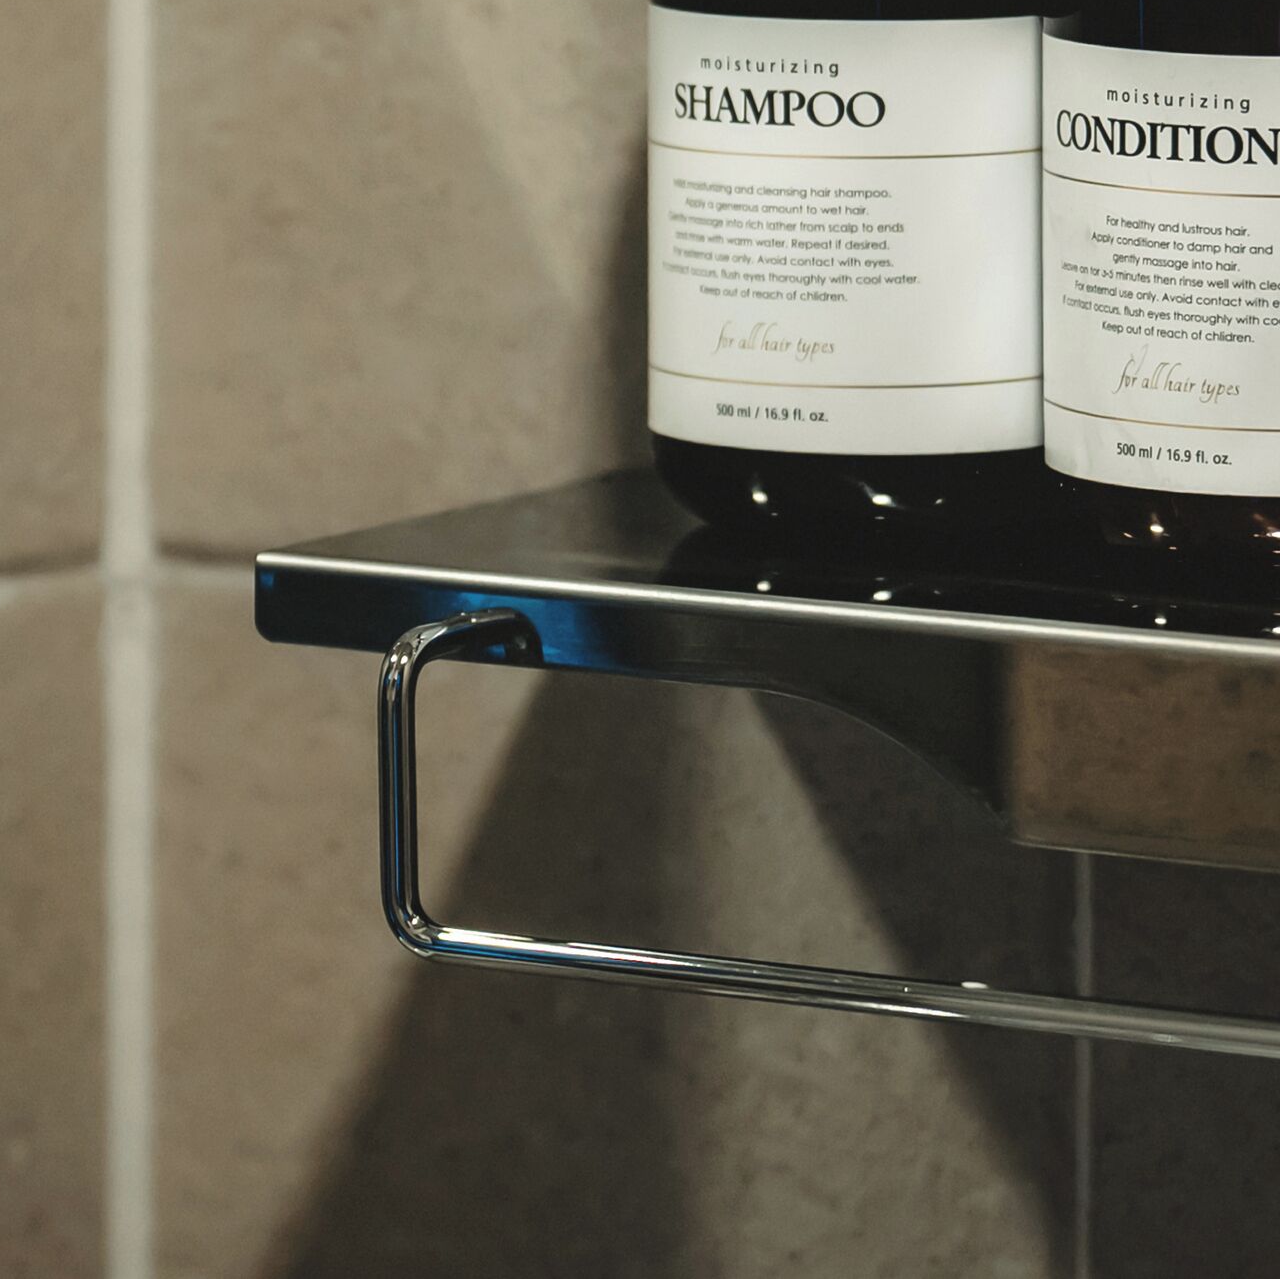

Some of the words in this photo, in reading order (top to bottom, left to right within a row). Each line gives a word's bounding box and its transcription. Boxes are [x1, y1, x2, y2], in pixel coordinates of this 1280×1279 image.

[700, 56, 840, 77] moisturizing
[674, 83, 885, 127] SHAMPOO
[1106, 88, 1251, 113] moisturizing
[735, 186, 753, 194] and
[757, 187, 807, 199] cleansing
[810, 188, 830, 198] hair
[834, 189, 892, 199] shampoo.
[762, 205, 802, 214] amount
[807, 206, 817, 214] to
[820, 206, 841, 214] wet
[845, 206, 868, 215] hair.
[766, 221, 797, 231] lather
[800, 222, 825, 232] from
[828, 223, 858, 234] scalp
[863, 224, 873, 232] to
[877, 223, 904, 232] ends
[1107, 215, 1118, 226] For
[1121, 218, 1155, 232] healthy
[1158, 223, 1178, 232] and
[1182, 224, 1222, 235] lustrous
[1225, 226, 1250, 237] hair.
[791, 239, 832, 250] Repeat
[836, 240, 841, 249] if
[845, 241, 889, 250] desired.
[1091, 232, 1114, 244] Apply
[1117, 236, 1170, 249] conditioner
[1173, 241, 1184, 251] to
[1187, 242, 1221, 254] damp
[1225, 244, 1246, 253] hair
[1250, 246, 1273, 255] and
[758, 256, 787, 265] Avoid
[790, 258, 834, 266] contact
[839, 258, 861, 266] with
[865, 260, 893, 268] eyes.
[1143, 258, 1188, 270] massage
[1192, 260, 1212, 270] into
[1216, 261, 1240, 271] hair.
[769, 273, 825, 285] thoroughly
[829, 275, 851, 284] with
[856, 275, 881, 285] cool
[884, 275, 920, 284] water.
[1116, 271, 1150, 283] minutes
[1154, 274, 1176, 285] then
[1179, 277, 1203, 288] rinse
[1207, 279, 1229, 288] well
[1232, 280, 1255, 289] with
[741, 289, 750, 298] of
[752, 290, 783, 299] reach
[786, 291, 796, 300] of
[1119, 290, 1133, 299] use
[1136, 291, 1159, 302] only.
[1162, 293, 1192, 304] Avoid
[1196, 296, 1241, 306] contact
[1245, 298, 1268, 307] with
[1124, 306, 1144, 317] flush
[1147, 311, 1171, 320] eyes
[1174, 312, 1232, 325] thoroughly
[1236, 315, 1259, 325] with
[1102, 321, 1123, 333] Keep
[1126, 326, 1141, 334] out
[1144, 327, 1154, 336] of
[1157, 328, 1188, 339] reach
[1191, 330, 1202, 340] of
[738, 321, 764, 351] all
[795, 337, 835, 362] types
[1142, 362, 1163, 389] all
[1201, 378, 1240, 403] types
[716, 403, 734, 417] 500
[737, 405, 751, 418] ml
[755, 406, 759, 419] /
[764, 406, 788, 420] 16.9
[793, 407, 805, 421] fl.
[809, 409, 828, 422] oz.
[1117, 442, 1135, 457] 500
[1139, 445, 1152, 459] ml
[1156, 447, 1162, 460] /
[1166, 448, 1192, 462] 16.9
[1196, 449, 1208, 464] fl.
[1213, 452, 1232, 465] oz.
